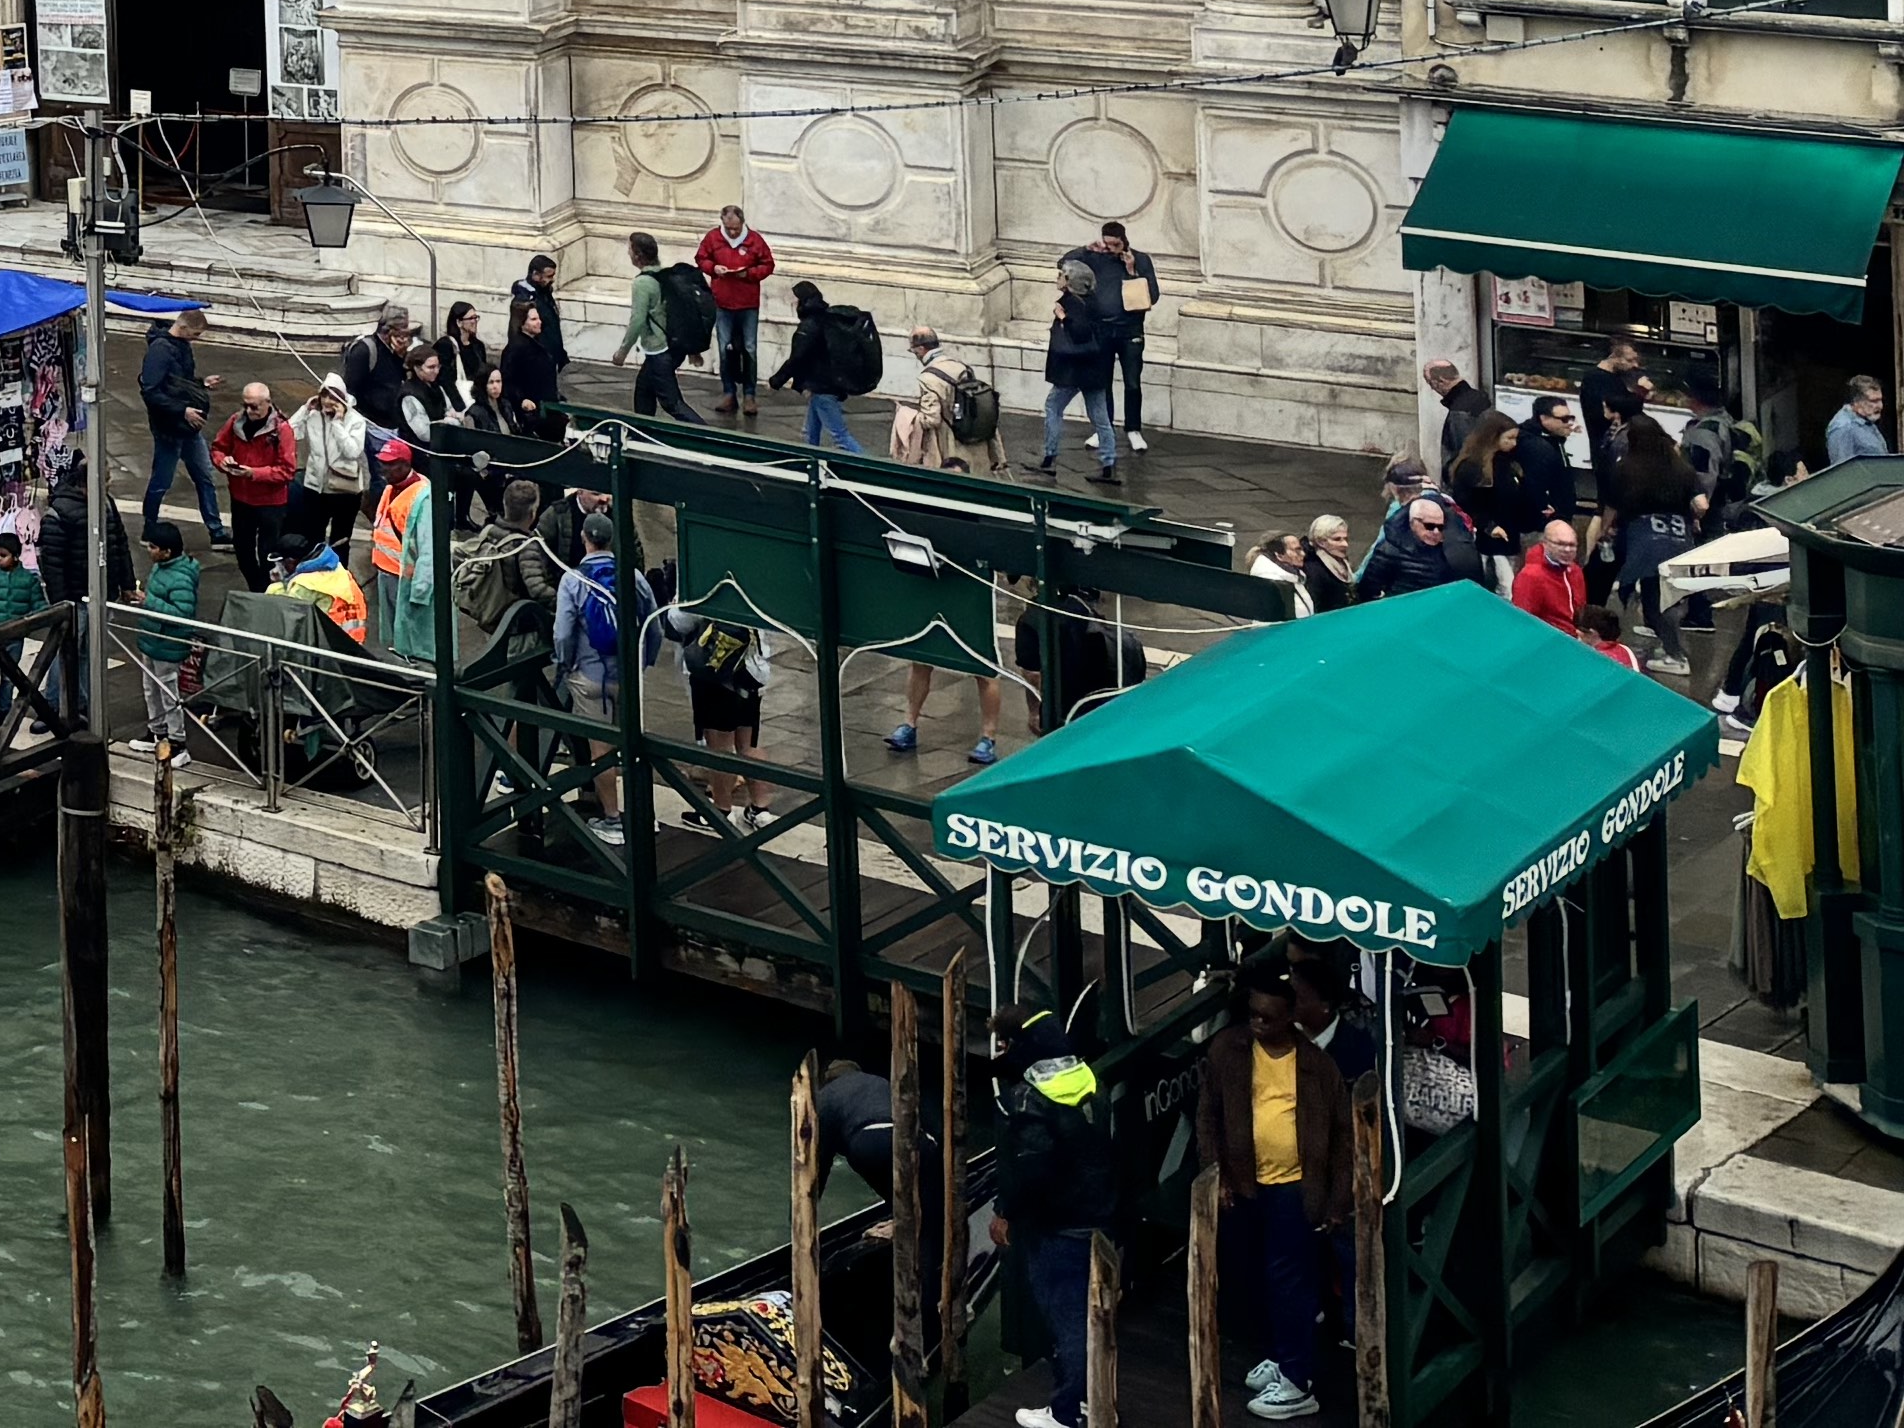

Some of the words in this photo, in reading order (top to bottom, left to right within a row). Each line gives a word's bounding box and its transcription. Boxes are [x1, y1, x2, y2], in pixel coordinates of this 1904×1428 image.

[946, 813, 1168, 892] SERVIZIO
[1186, 866, 1438, 950] GONDOLE
[1501, 829, 1590, 920] SERVIZIO
[1601, 749, 1685, 844] GONDOLE
